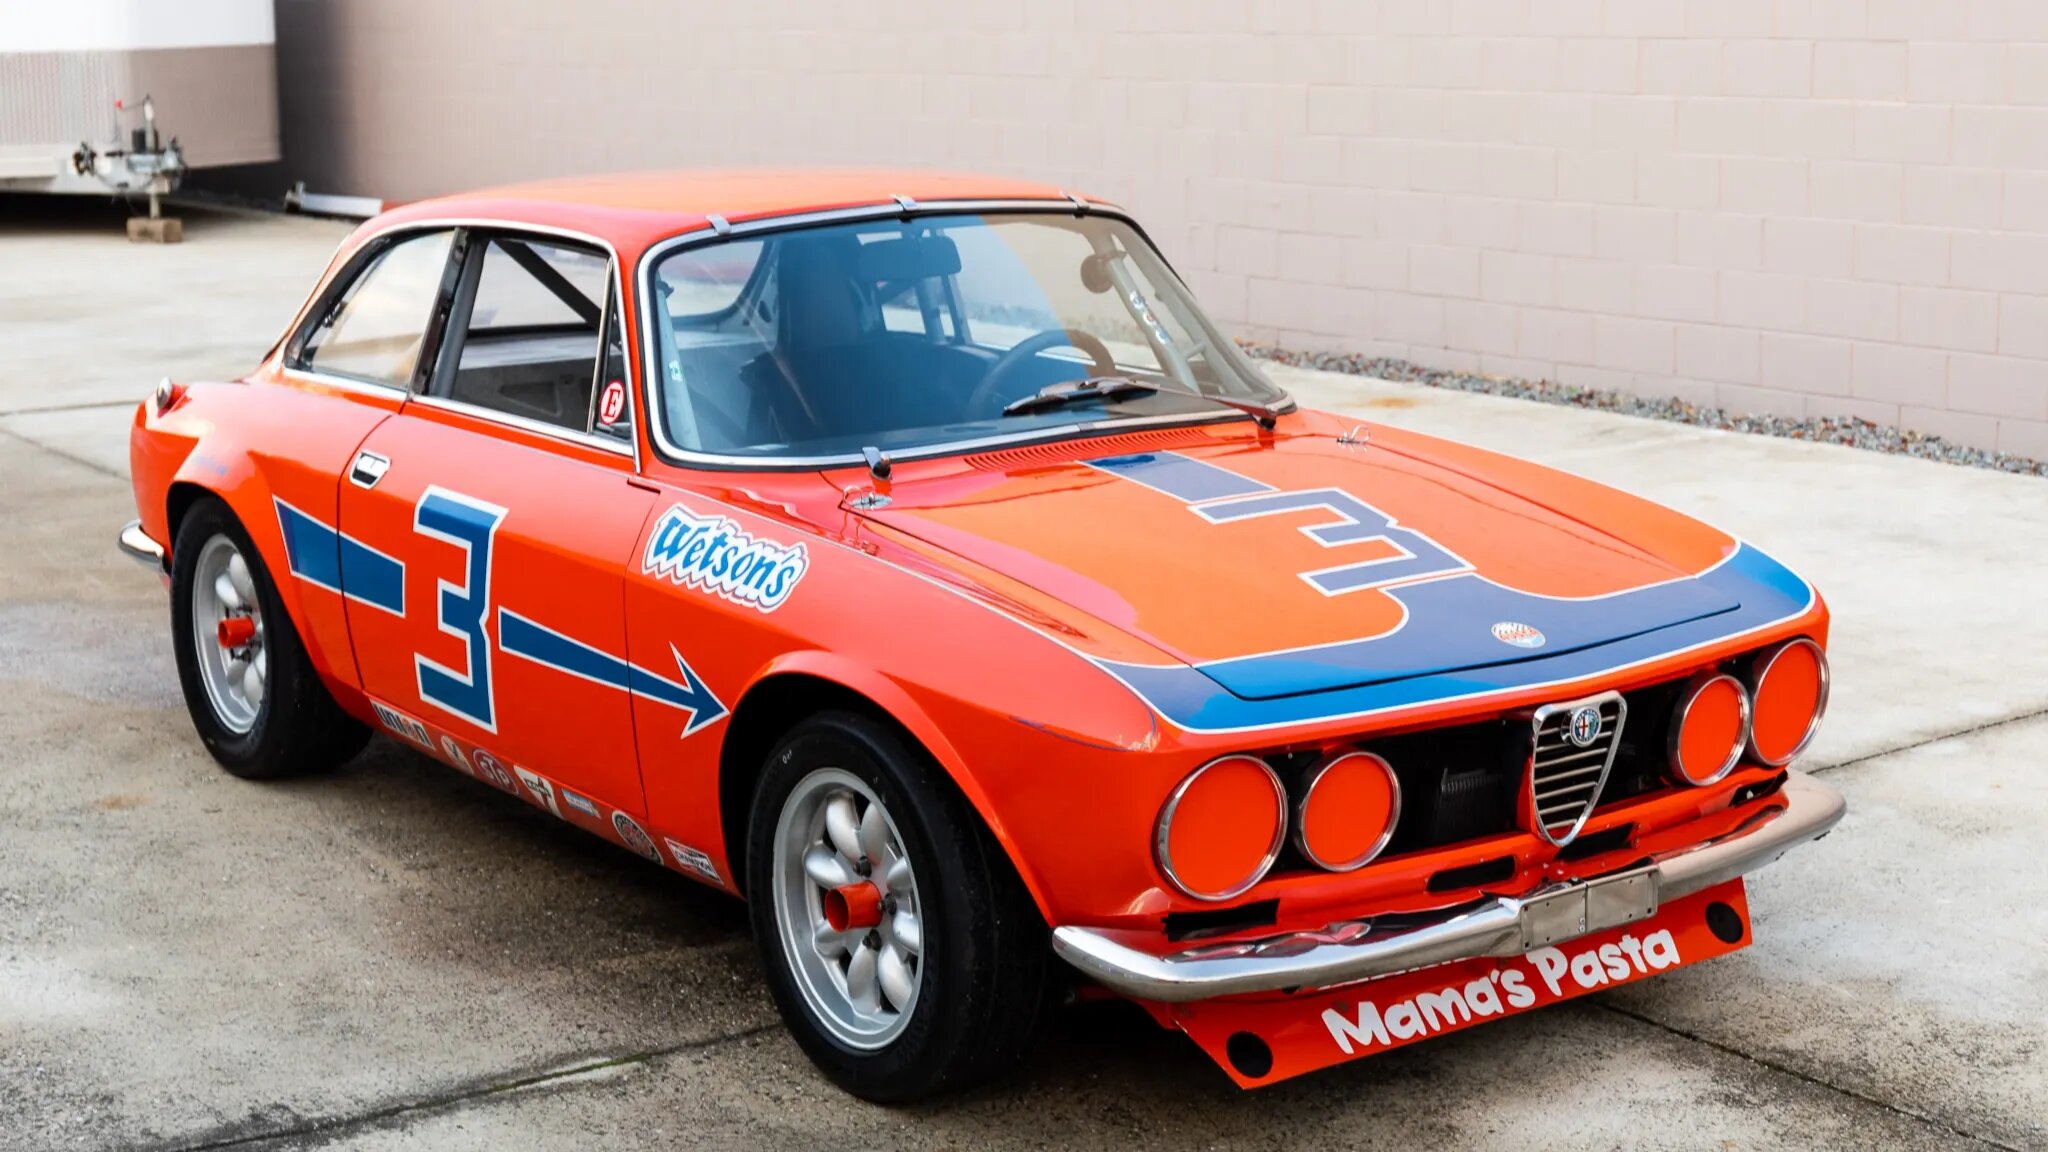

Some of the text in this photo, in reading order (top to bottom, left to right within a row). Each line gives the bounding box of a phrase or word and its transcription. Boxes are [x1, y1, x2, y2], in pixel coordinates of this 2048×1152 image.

[603, 388, 621, 418] E
[653, 515, 795, 598] Wetson's
[1187, 487, 1477, 597] 3
[413, 484, 509, 735] 3
[1321, 928, 1681, 1055] Mama's Pasta
